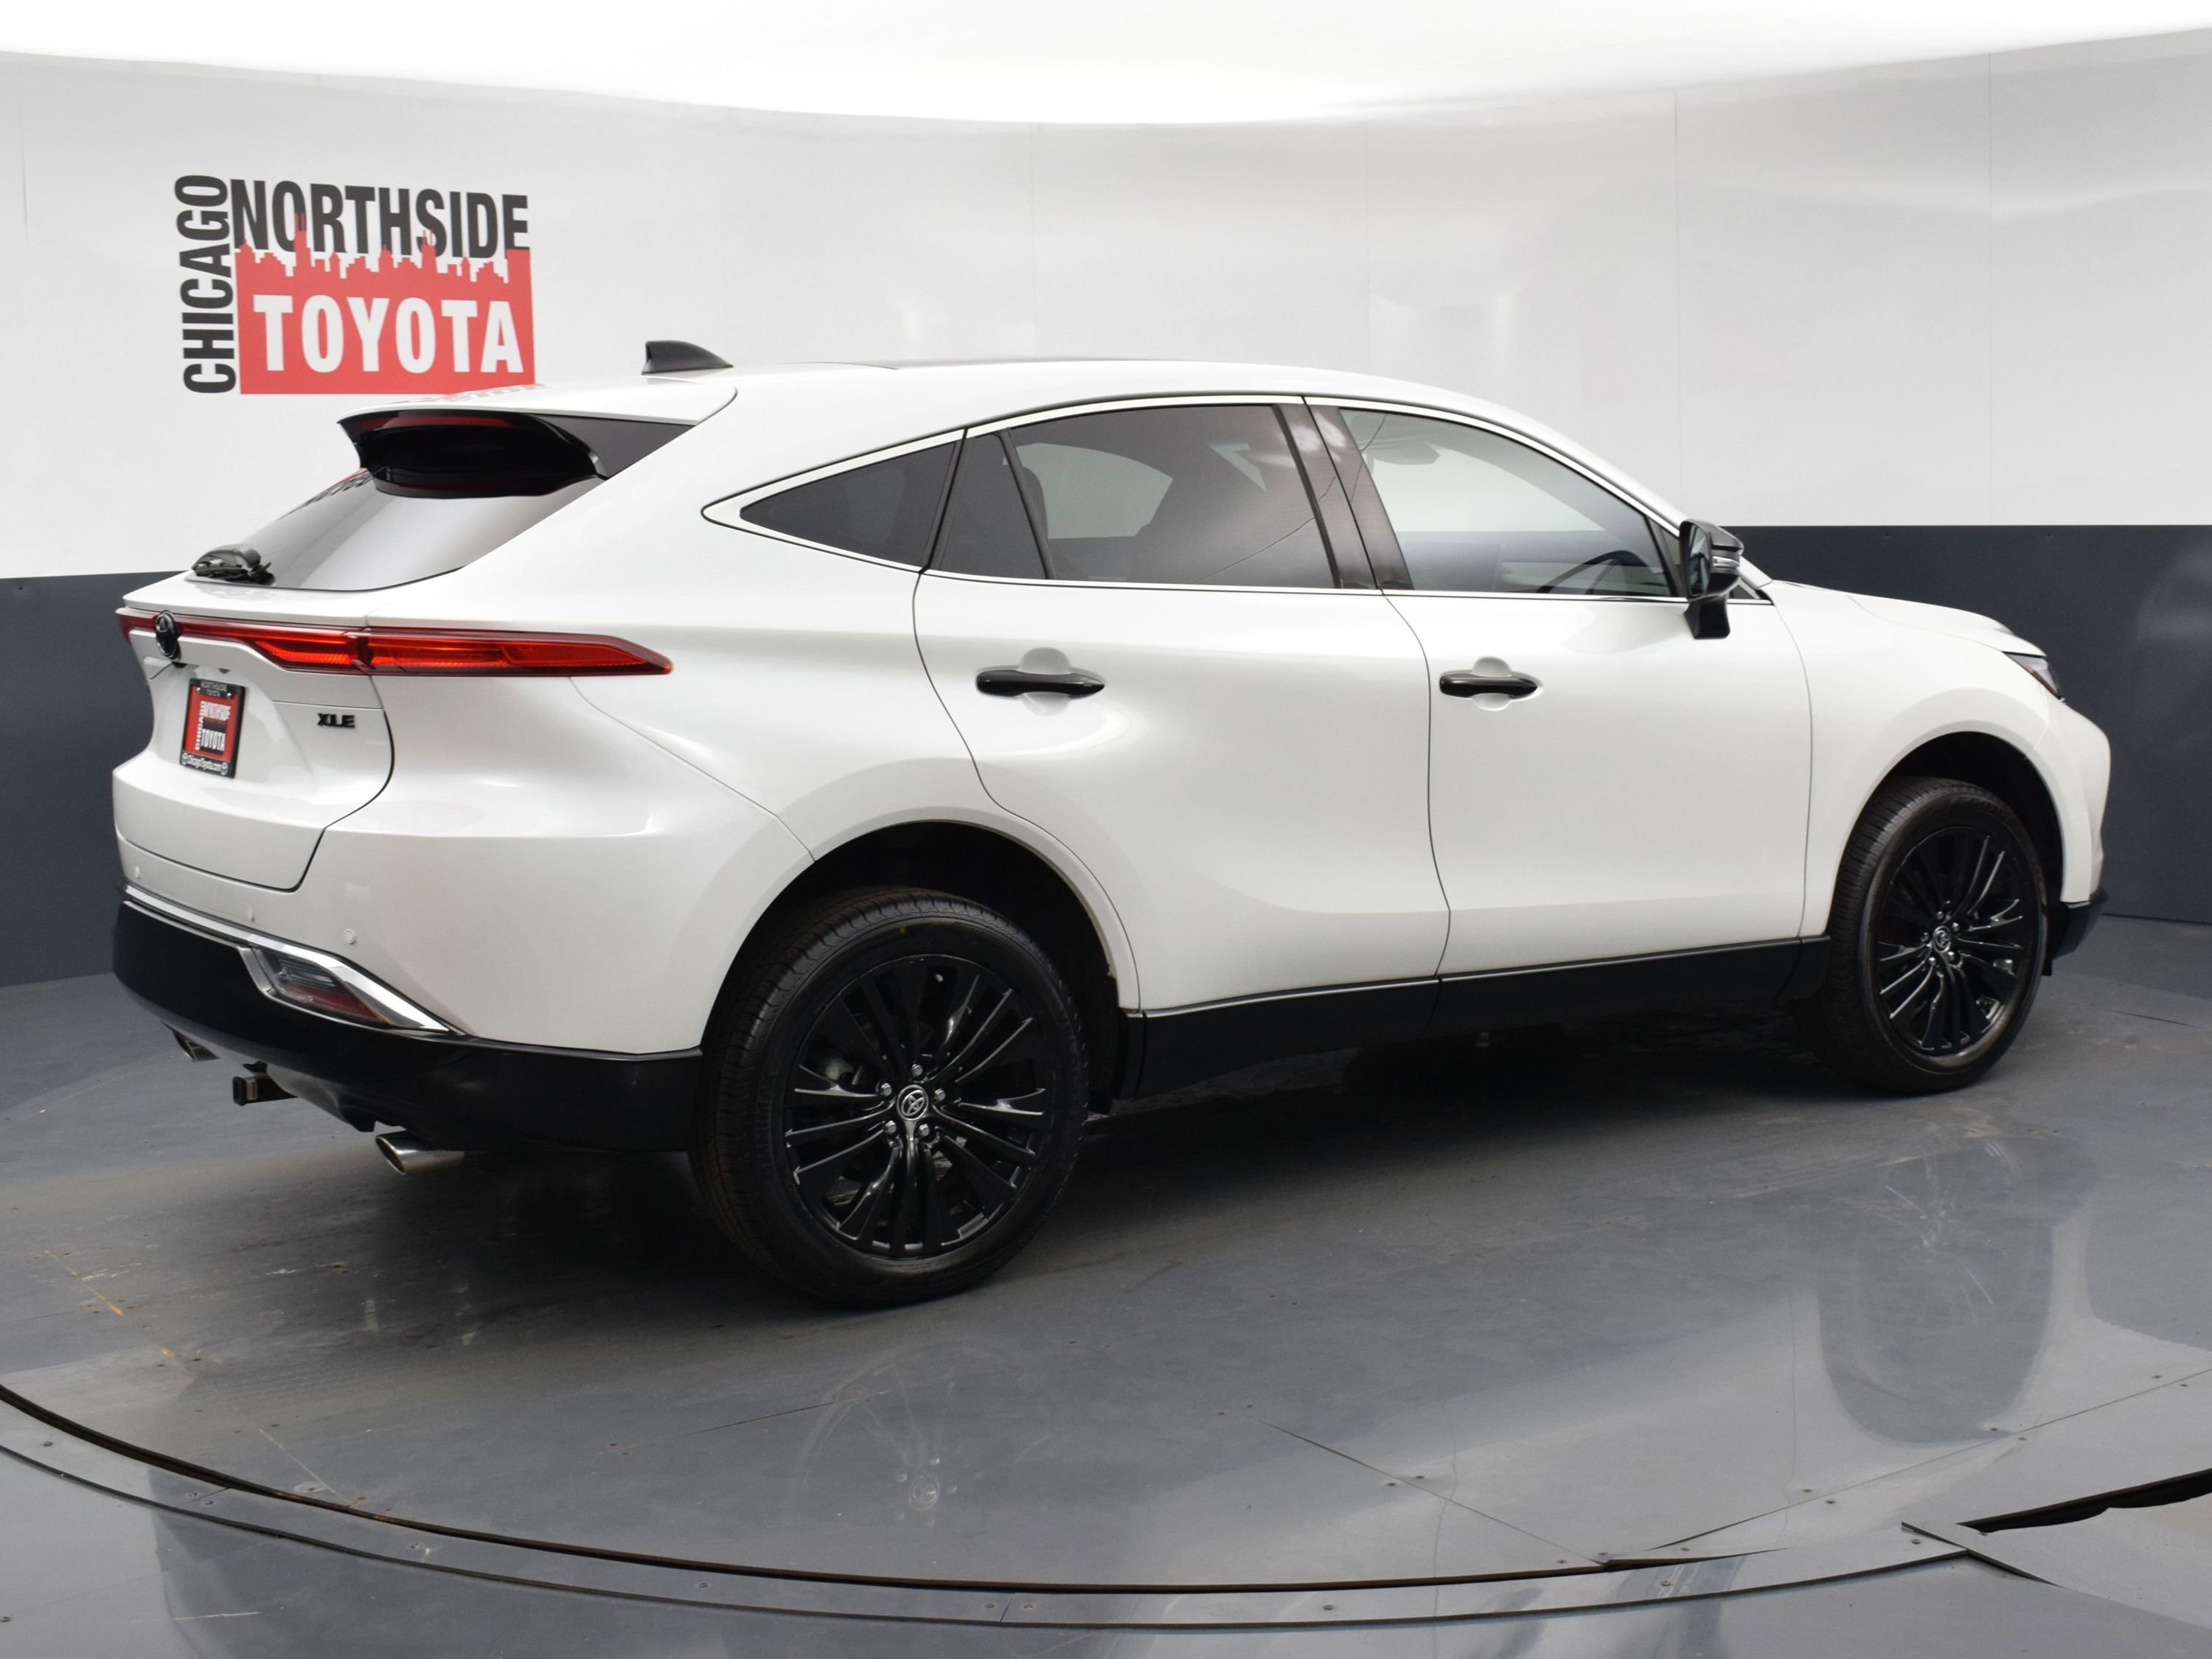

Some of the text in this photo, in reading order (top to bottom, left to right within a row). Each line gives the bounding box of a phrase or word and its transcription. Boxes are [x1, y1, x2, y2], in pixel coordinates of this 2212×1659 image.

[231, 178, 529, 259] NORTHSIDE
[174, 175, 237, 394] CHICAGO
[253, 294, 524, 374] TOYOTA
[201, 728, 226, 751] TOYOTA
[317, 713, 355, 728] XLE
